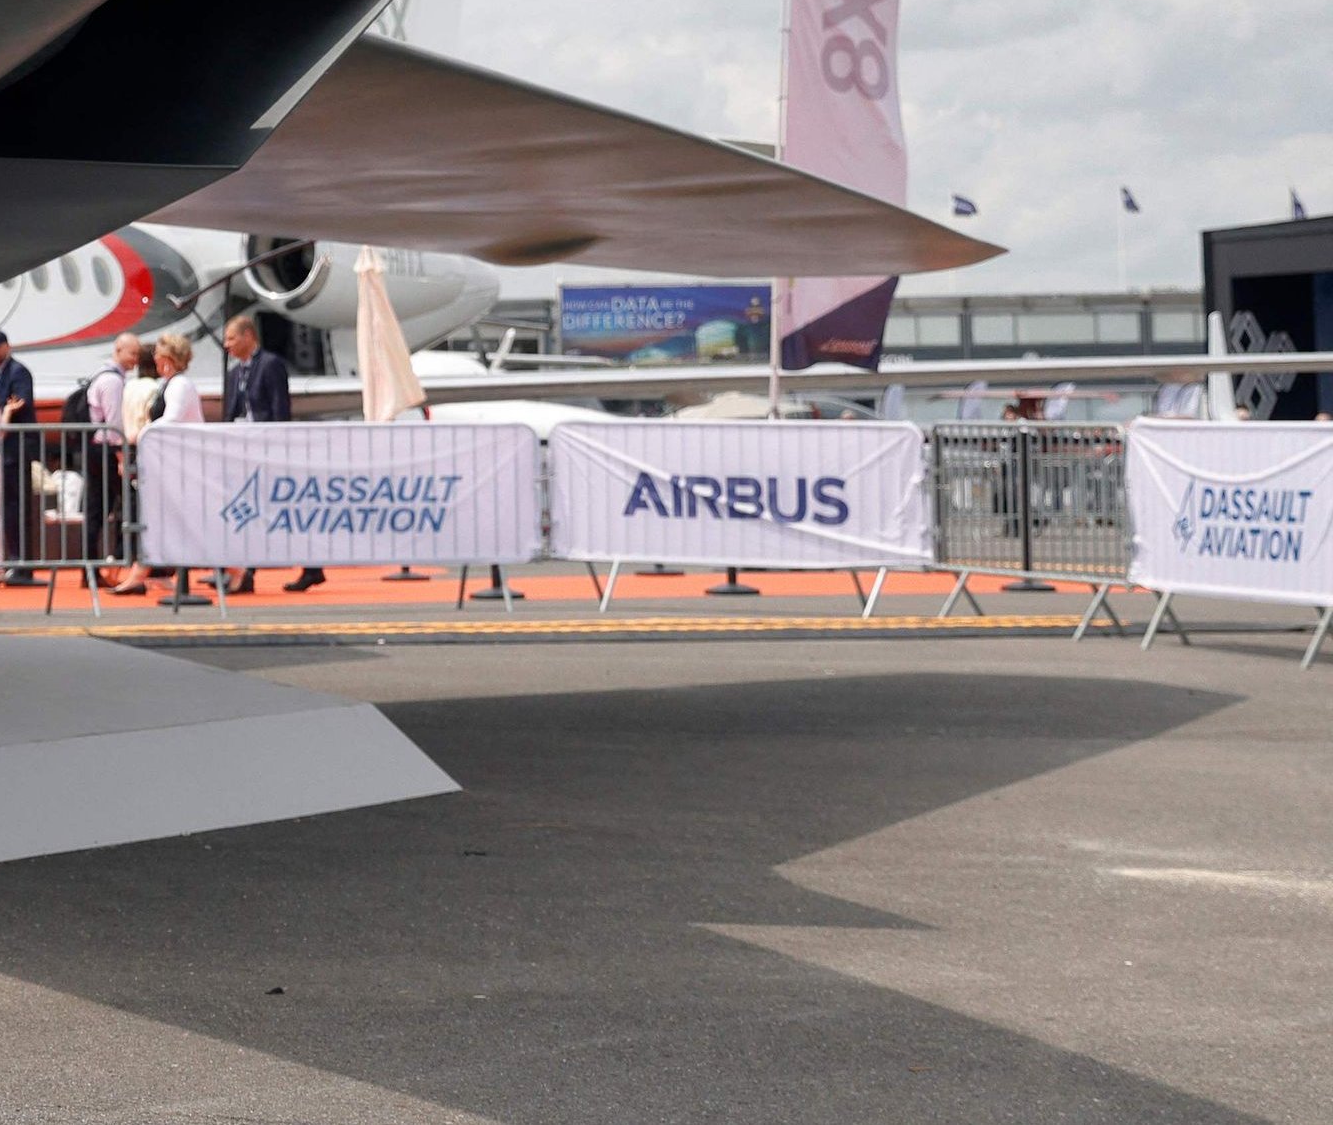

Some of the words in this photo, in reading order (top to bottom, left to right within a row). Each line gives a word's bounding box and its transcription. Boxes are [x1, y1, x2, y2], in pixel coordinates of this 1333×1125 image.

[611, 295, 659, 313] DATA
[269, 475, 462, 503] DASSAULT
[623, 472, 849, 526] AIRBUS
[266, 507, 446, 534] AVIATION
[1200, 488, 1312, 523] DASSAULT
[1198, 526, 1303, 561] AVIATION
